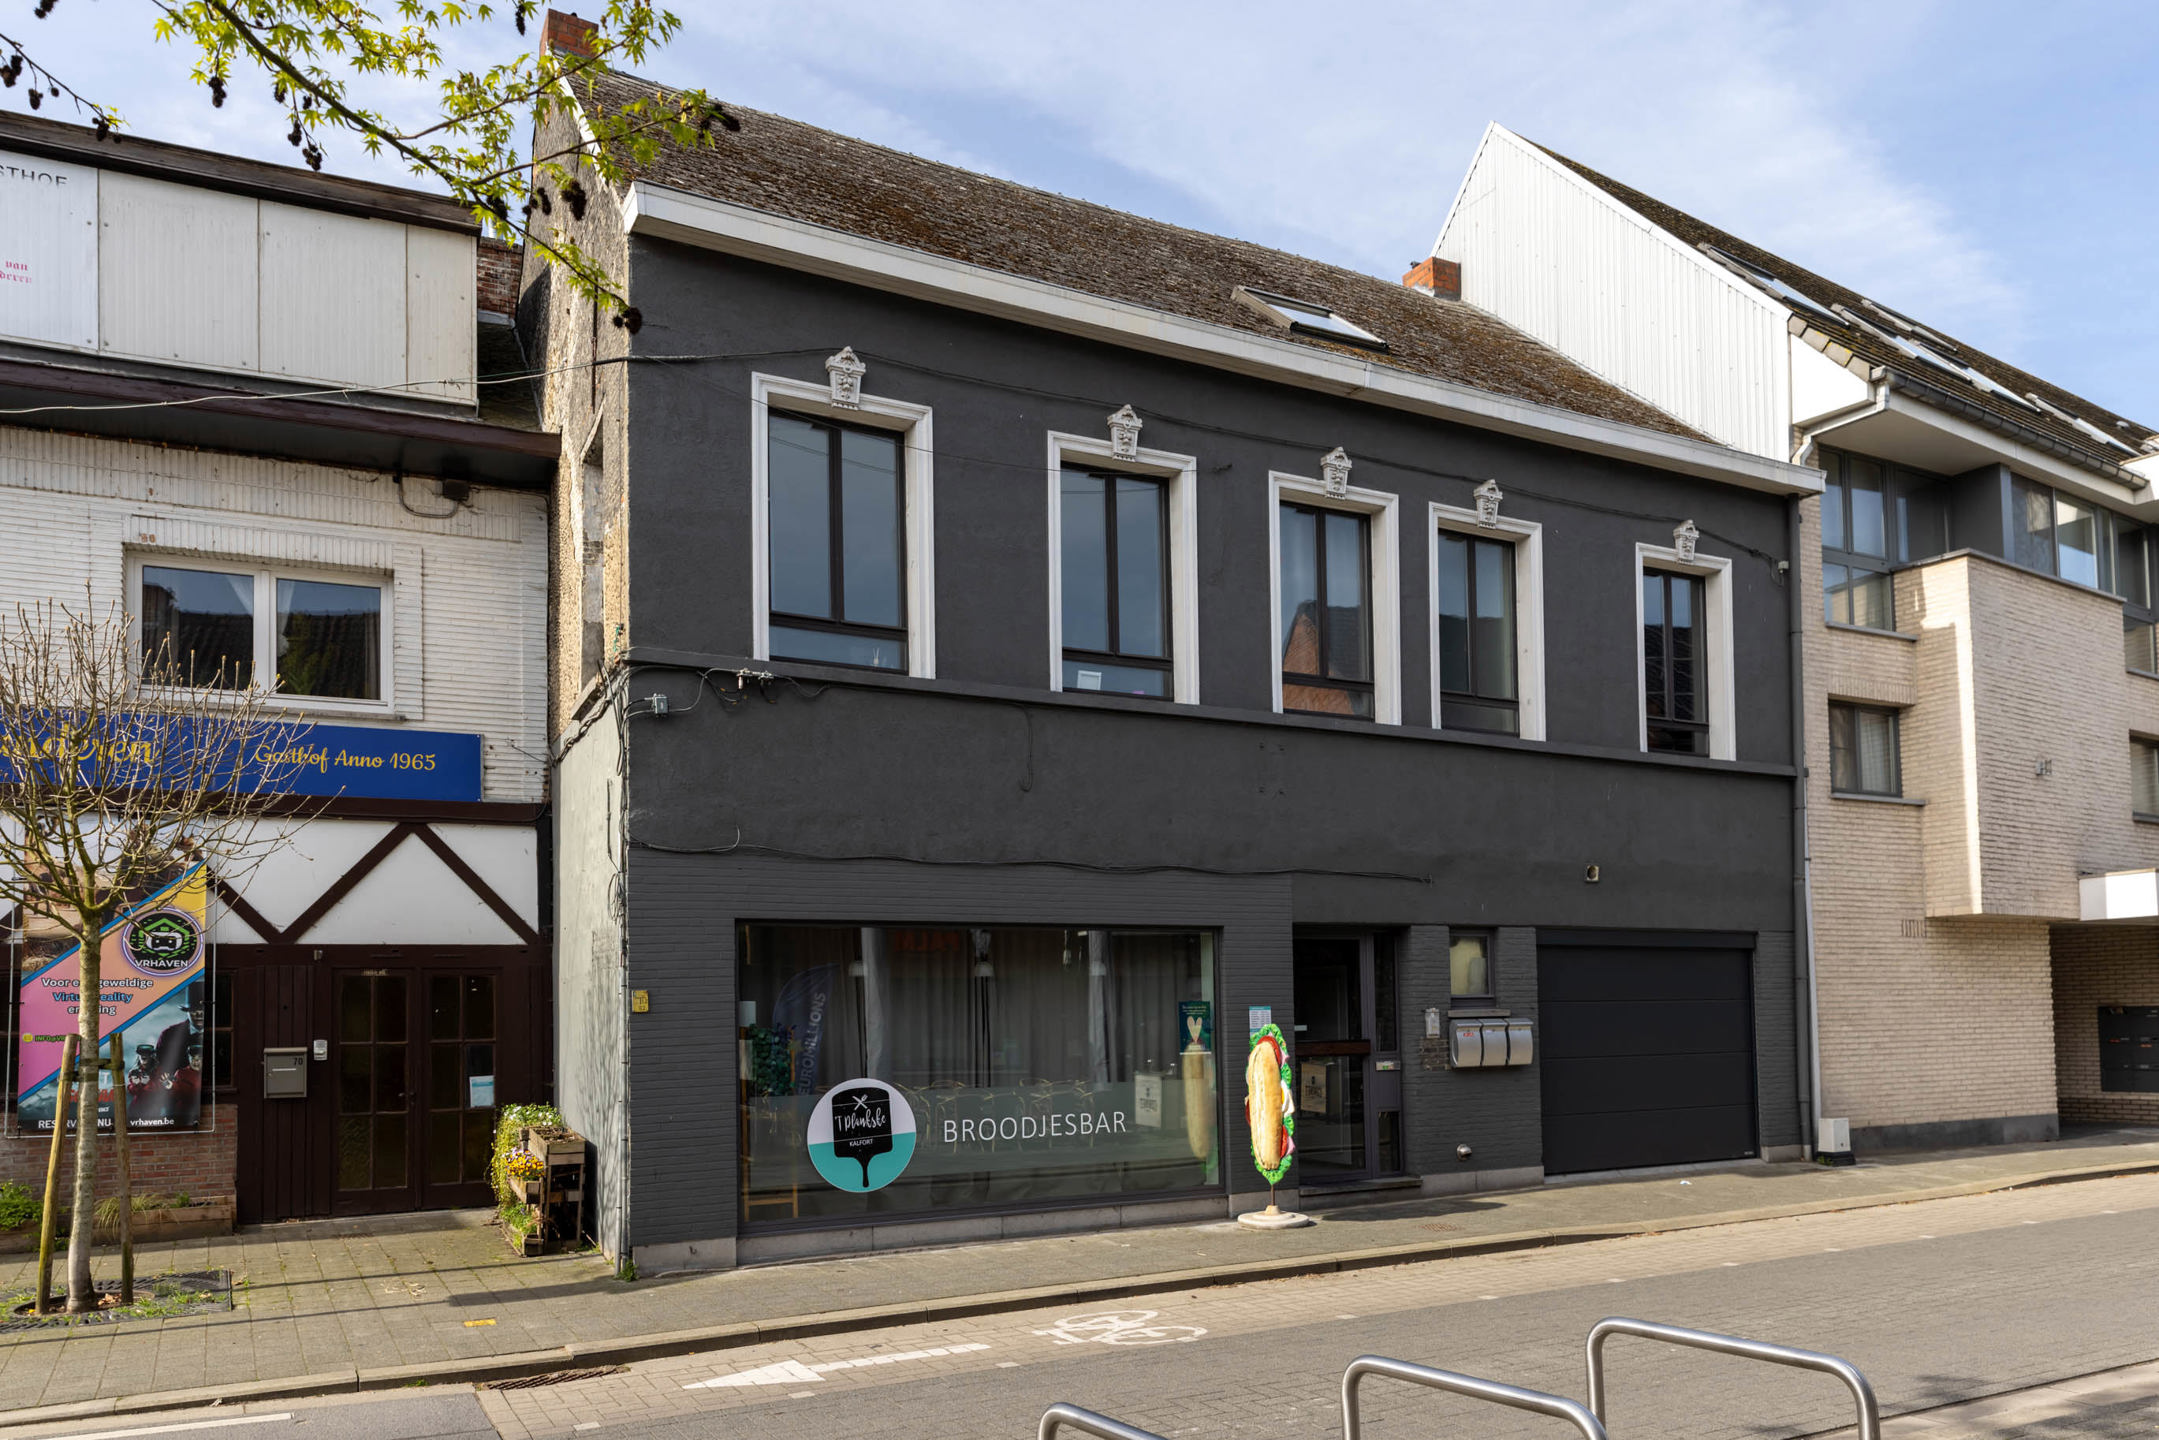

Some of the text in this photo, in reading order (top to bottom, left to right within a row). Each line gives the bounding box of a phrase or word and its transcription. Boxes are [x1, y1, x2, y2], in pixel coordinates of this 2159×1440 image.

[255, 745, 436, 773] Gasthof Anno 1965
[135, 959, 188, 967] VRHAVEN
[42, 978, 69, 987] Voor
[100, 992, 133, 1003] eality
[293, 1057, 304, 1066] 70
[130, 1117, 174, 1126] vrhaven.be
[943, 1111, 1126, 1143] BROODJESBAR
[849, 1139, 873, 1147] KALFORT
